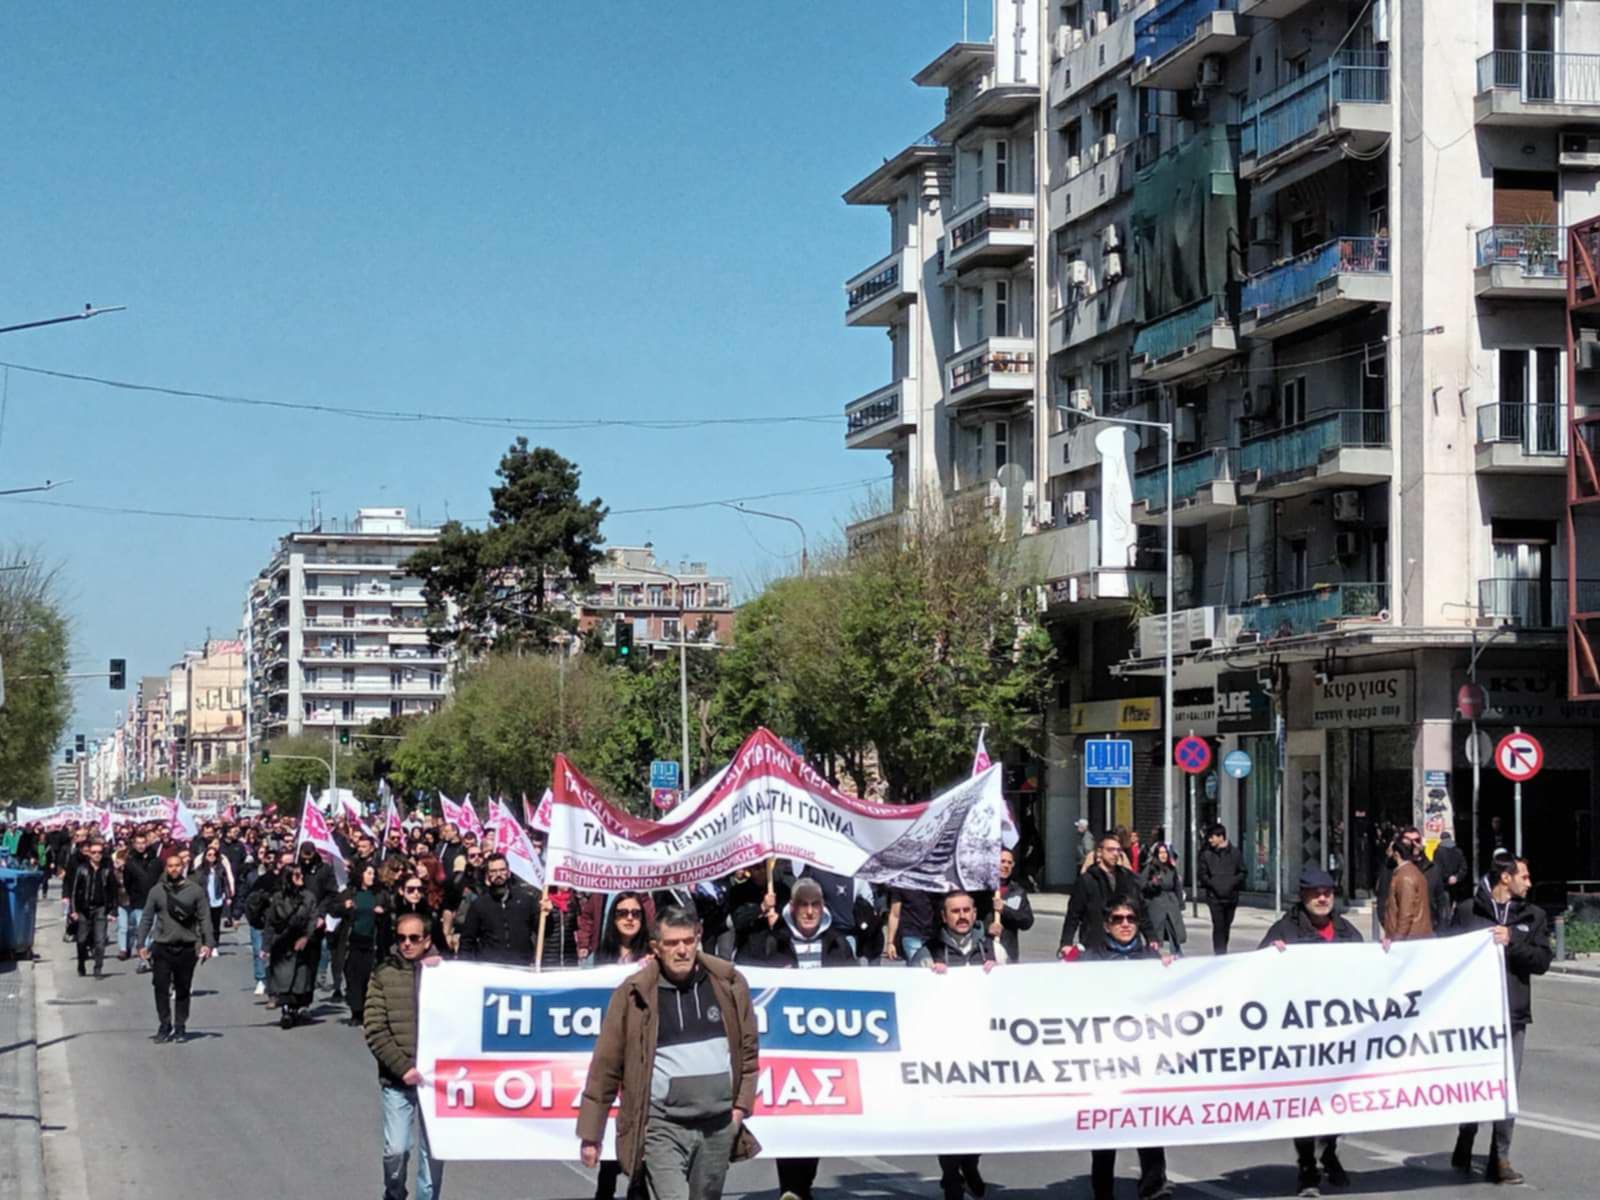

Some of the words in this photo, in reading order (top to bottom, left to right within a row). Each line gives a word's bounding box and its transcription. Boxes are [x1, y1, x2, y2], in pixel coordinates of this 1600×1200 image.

[583, 822, 606, 848] ΤΑ
[798, 800, 855, 837] ΓΩΝΙΑ
[485, 993, 533, 1036] Ή
[549, 1006, 603, 1036] τα
[783, 1006, 889, 1045] τους
[1240, 1001, 1268, 1031] Ο
[1281, 990, 1423, 1030] ΑΓΩΝΑΣ
[900, 1059, 1045, 1085] ΕΝΑΝΤΙΑ
[1052, 1056, 1141, 1083] ΣΤΗΝ
[1154, 1039, 1356, 1076] ΑΝΤΕΡΓΑΤΙΚΗ
[1365, 1024, 1507, 1060] ΠΟΛΙΤΙΚΗ
[446, 1066, 475, 1108] ή
[493, 1069, 553, 1109] ΟΙ
[1076, 1104, 1195, 1131] ΕΡΓΑΤΙΚΑ
[1201, 1095, 1323, 1125] ΣΩΜΑΤΕΙΑ
